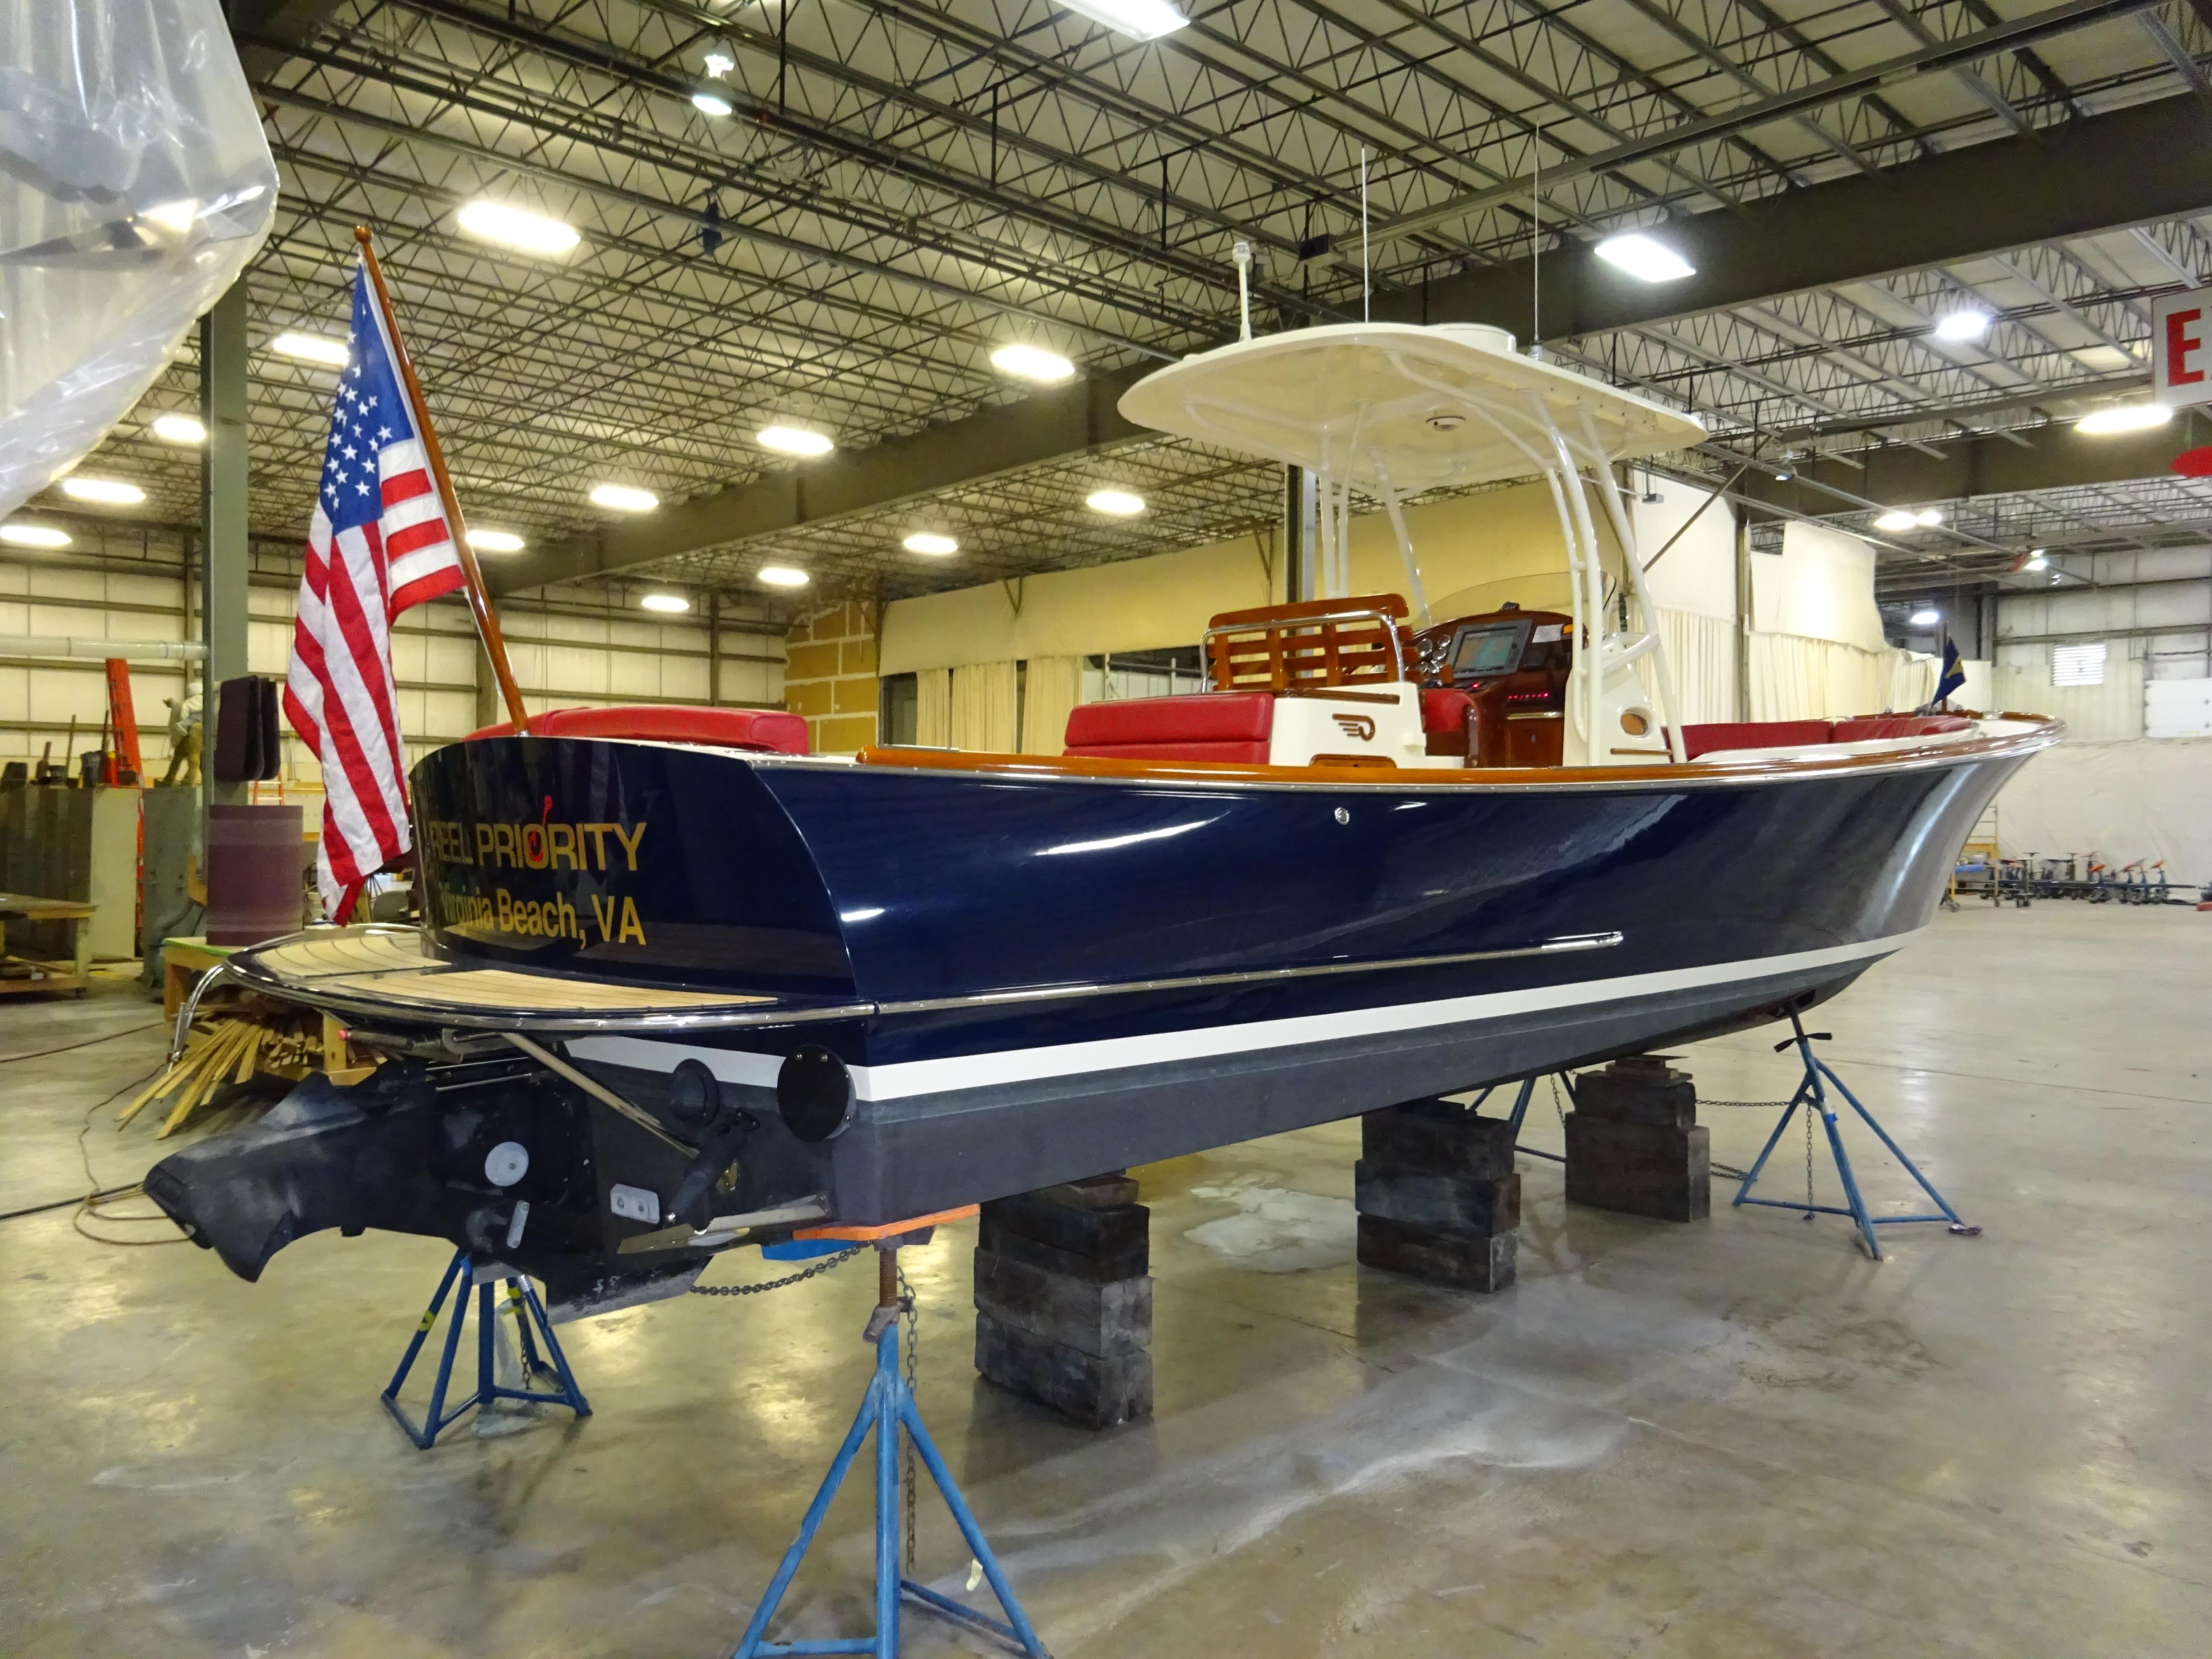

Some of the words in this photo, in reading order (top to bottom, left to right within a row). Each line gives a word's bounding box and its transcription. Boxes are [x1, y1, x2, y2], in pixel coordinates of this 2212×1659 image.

[430, 821, 473, 864] REEL
[476, 822, 647, 871] PRIORITY
[497, 888, 586, 950] Beach,
[591, 894, 647, 946] VA
